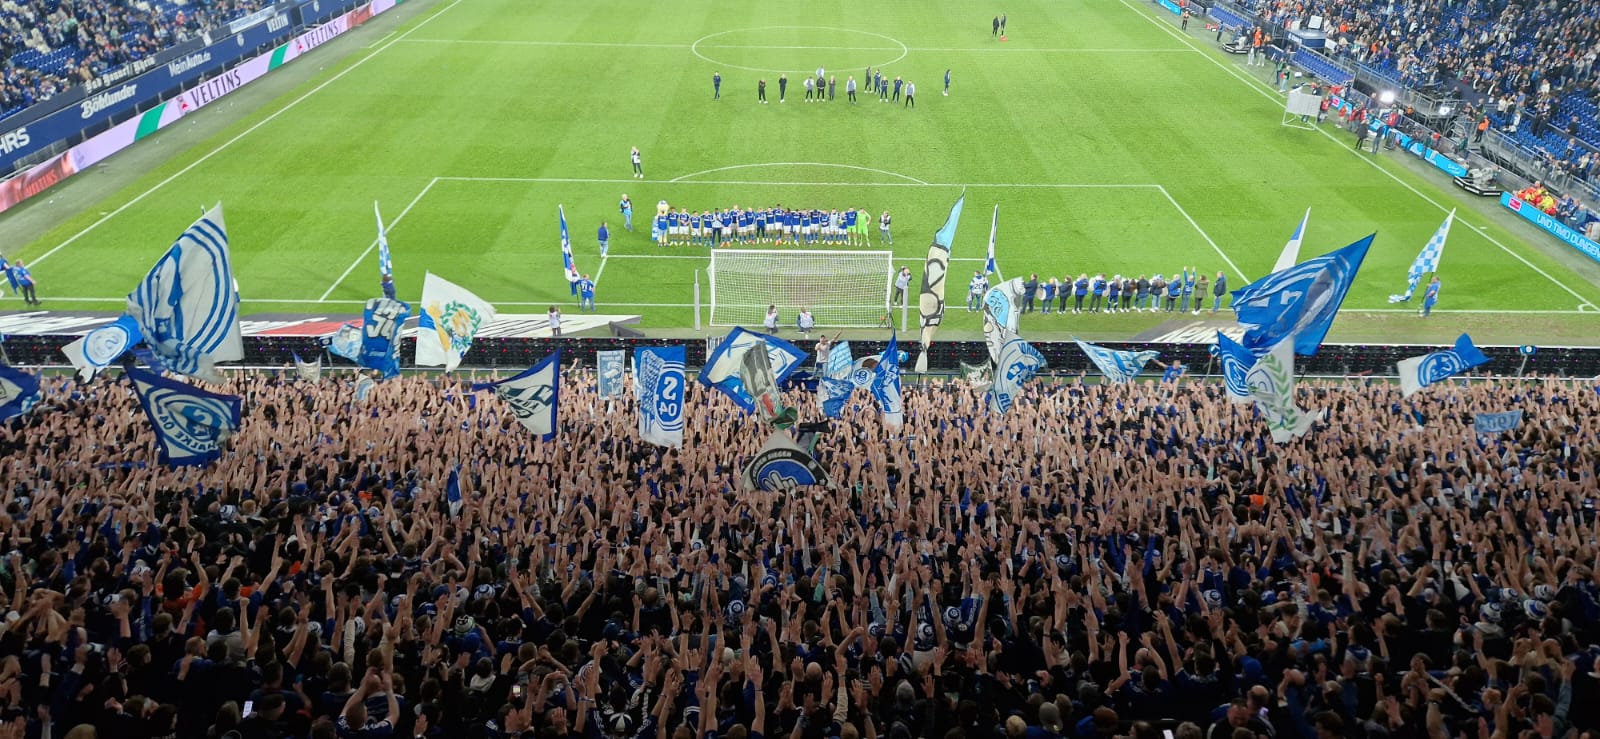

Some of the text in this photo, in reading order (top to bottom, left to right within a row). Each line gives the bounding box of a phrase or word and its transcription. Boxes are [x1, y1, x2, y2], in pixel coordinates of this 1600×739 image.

[304, 21, 339, 48] VELTINS
[80, 84, 137, 118] Böklunder
[190, 69, 241, 107] VELTINS
[1536, 214, 1552, 229] UND
[1553, 222, 1570, 239] TIMO
